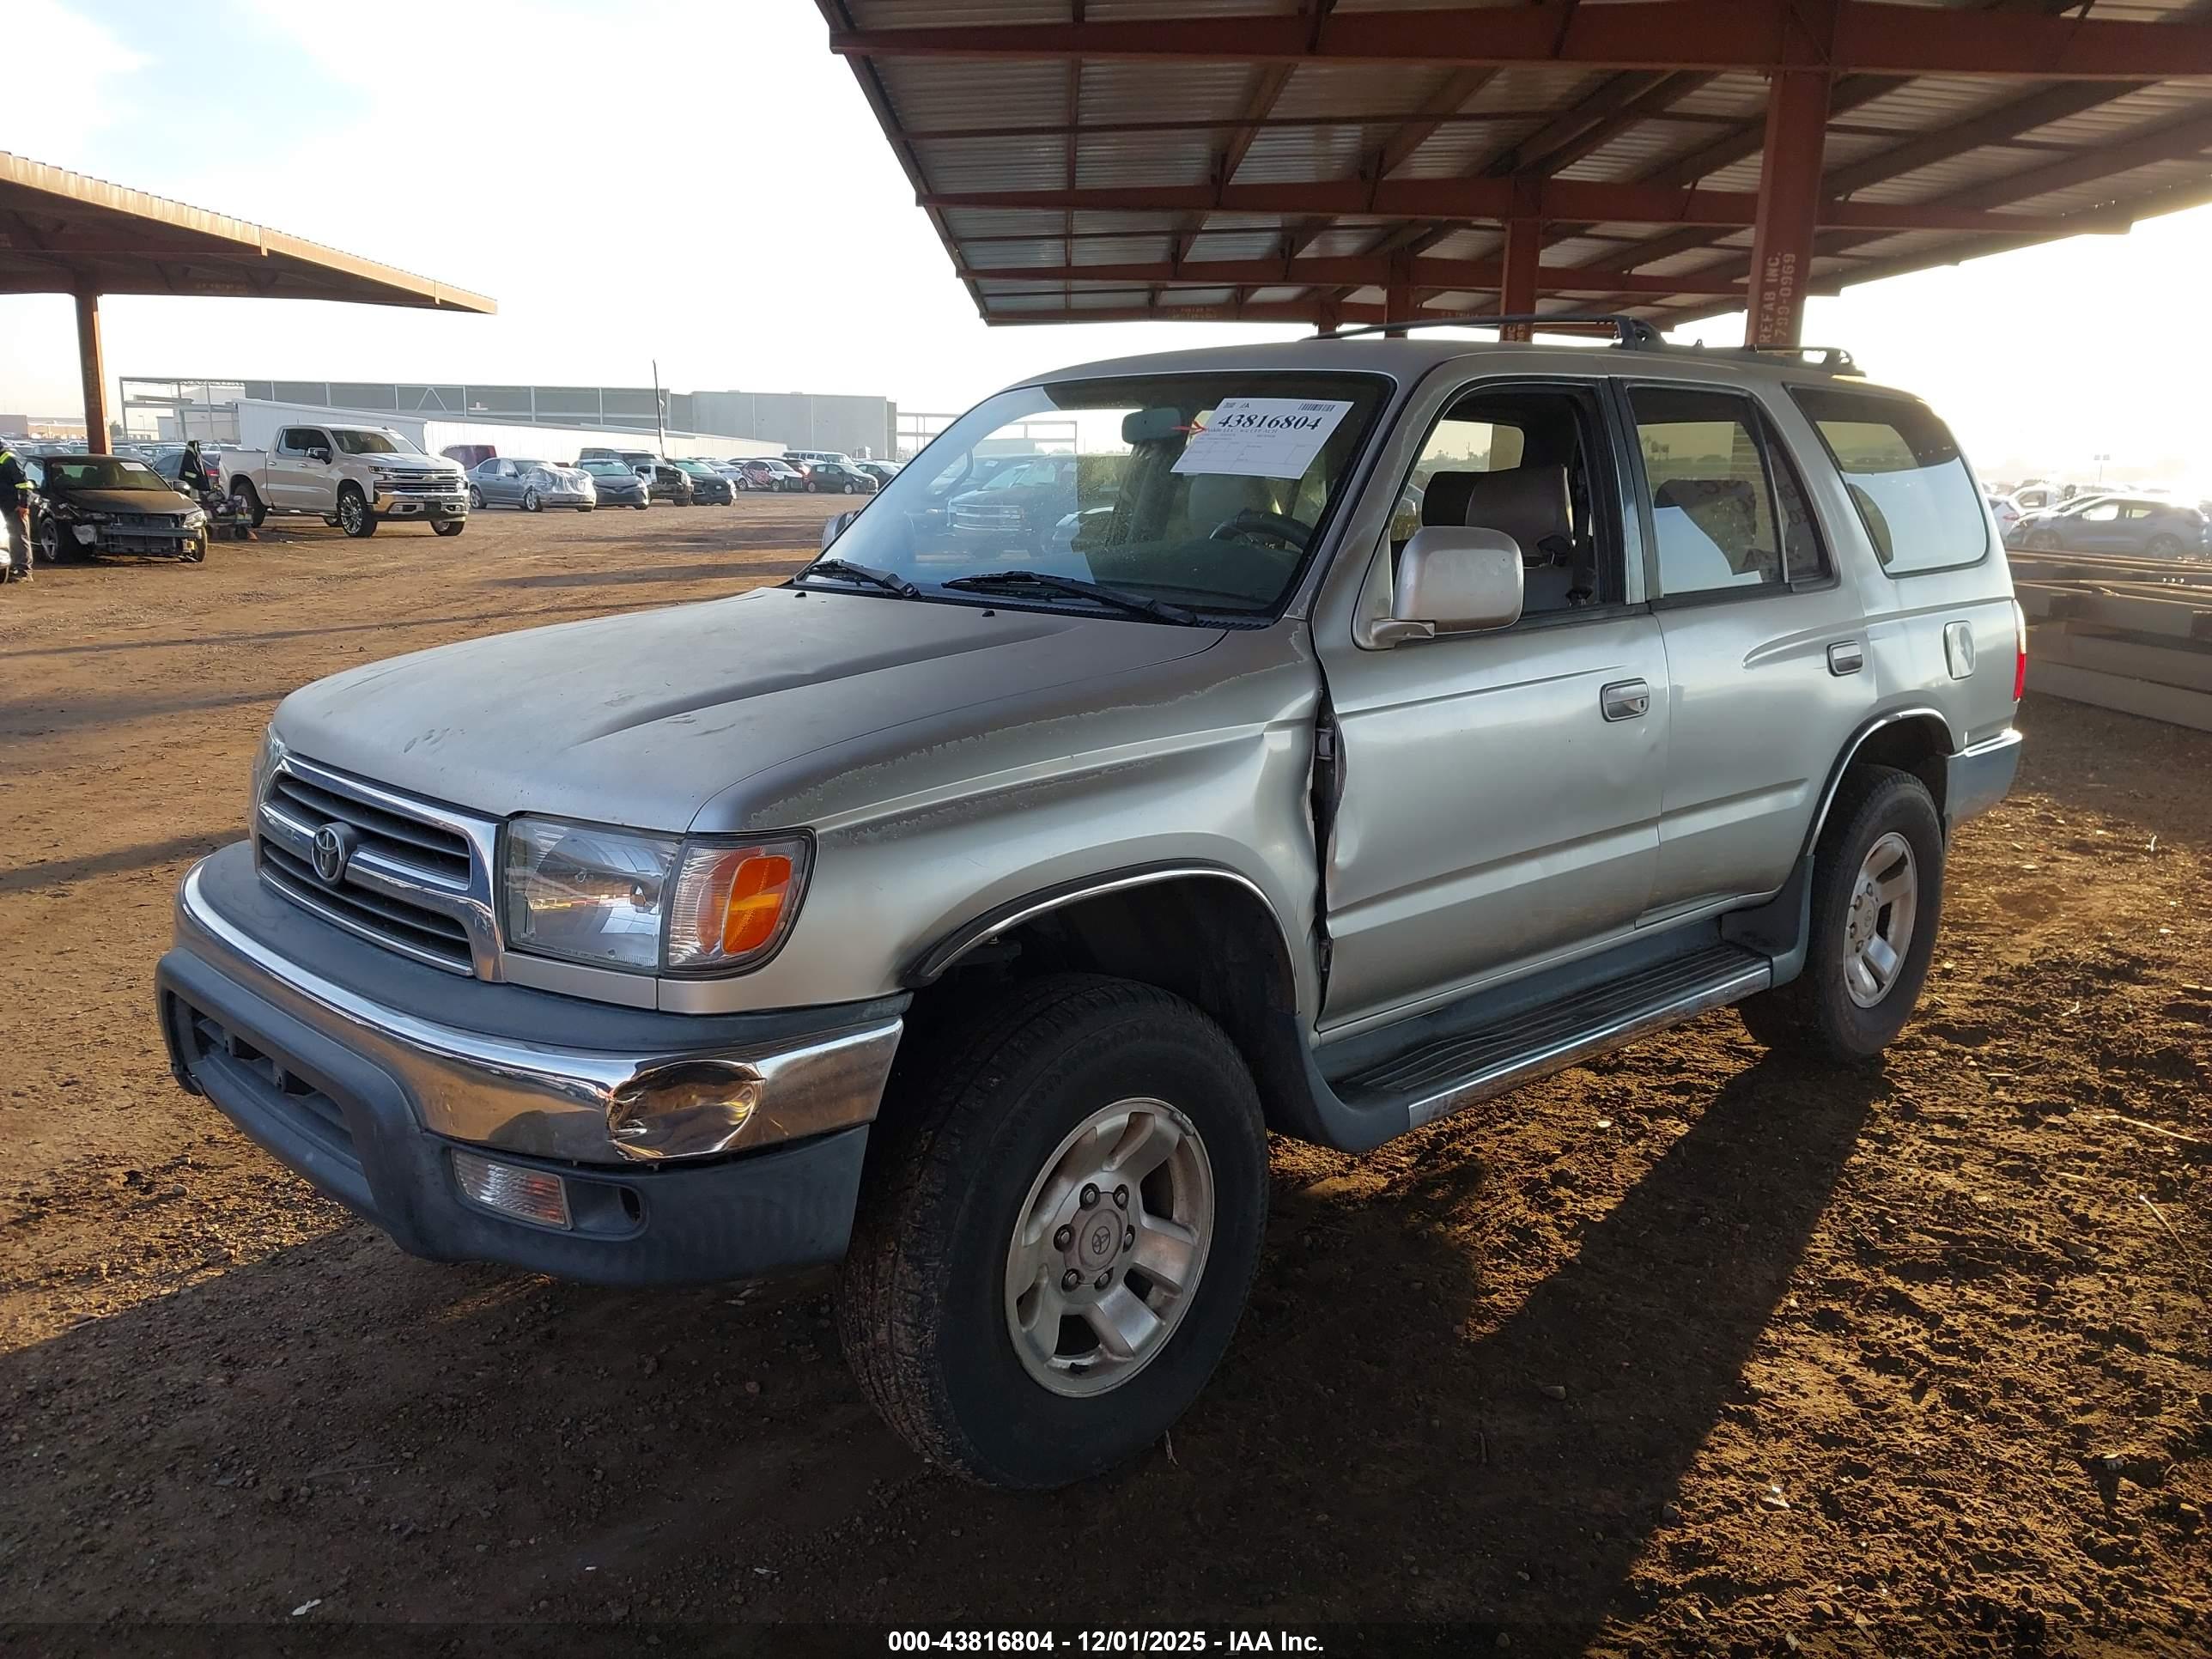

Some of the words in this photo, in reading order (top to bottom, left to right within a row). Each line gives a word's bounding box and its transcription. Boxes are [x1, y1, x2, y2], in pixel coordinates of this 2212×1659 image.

[1765, 251, 1782, 282] INC.
[1759, 291, 1777, 343] REFAB
[1218, 414, 1322, 430] 43816804
